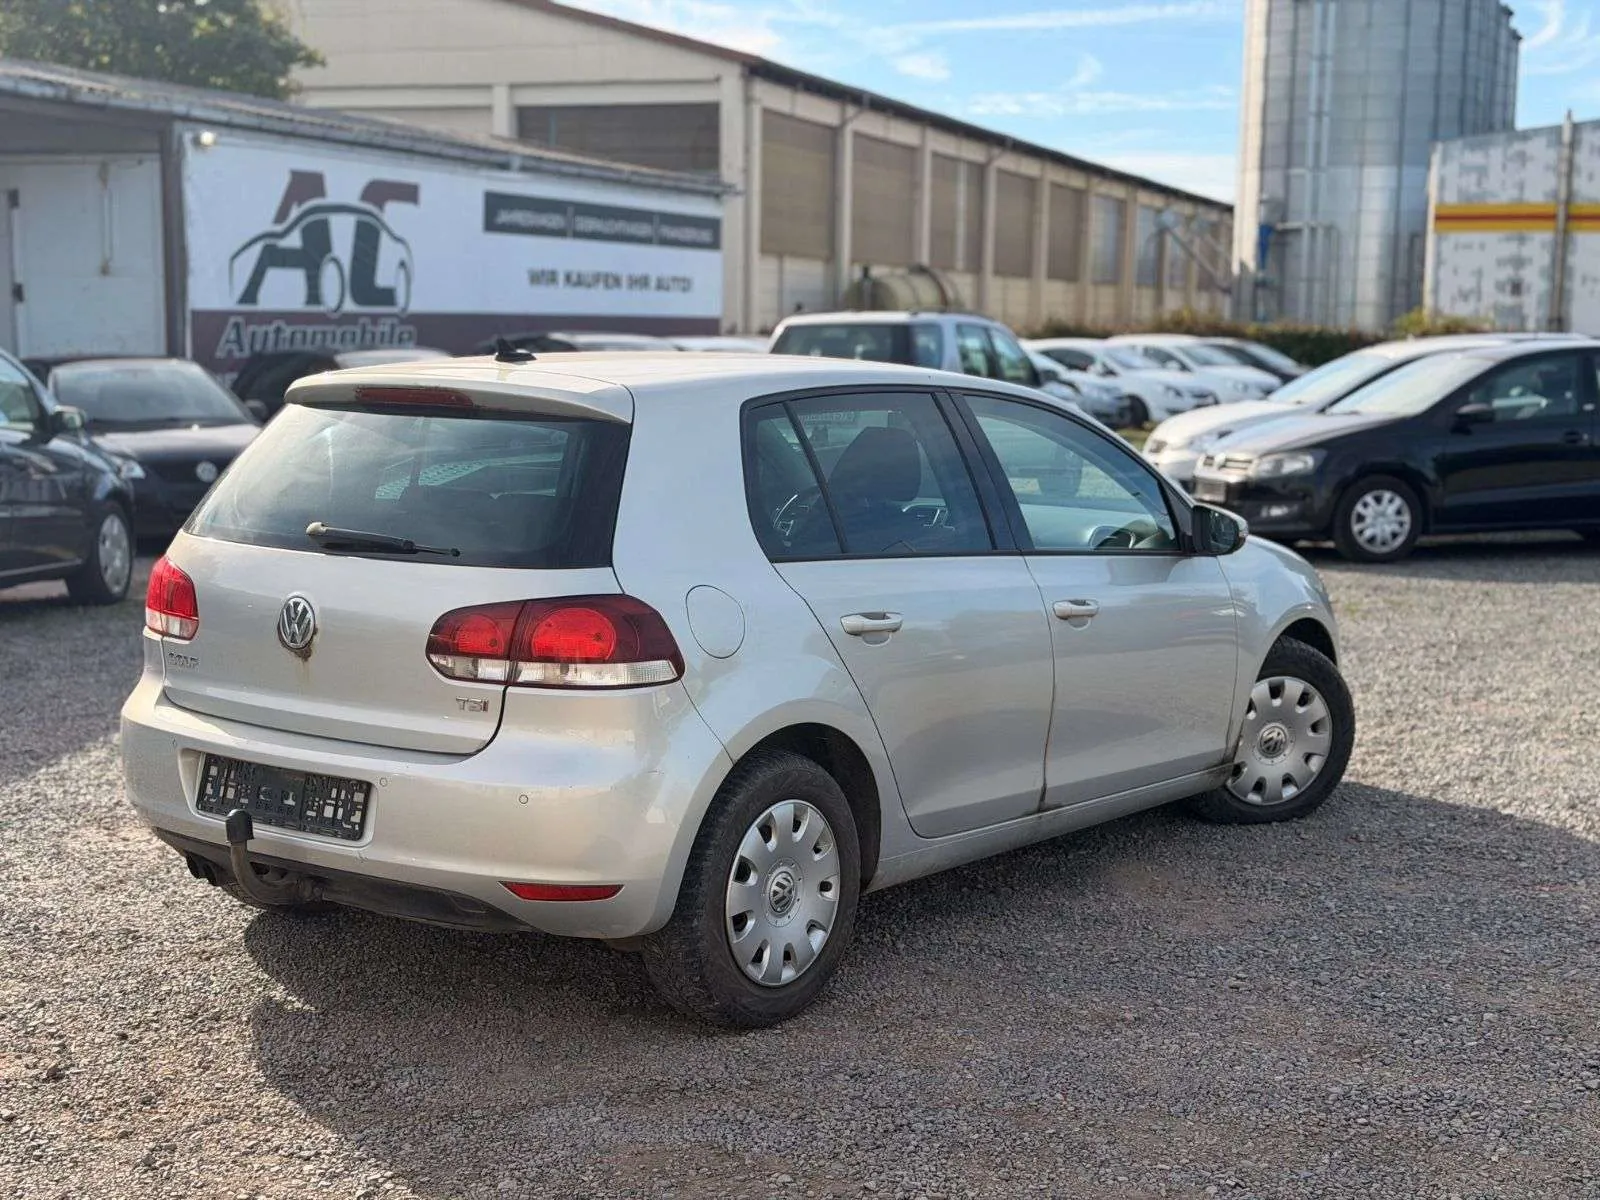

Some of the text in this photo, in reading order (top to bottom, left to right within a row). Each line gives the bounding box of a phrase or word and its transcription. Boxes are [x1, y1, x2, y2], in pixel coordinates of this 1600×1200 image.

[563, 271, 622, 290] KAUFEN
[215, 316, 415, 358] Automobile
[456, 697, 489, 712] TSI
